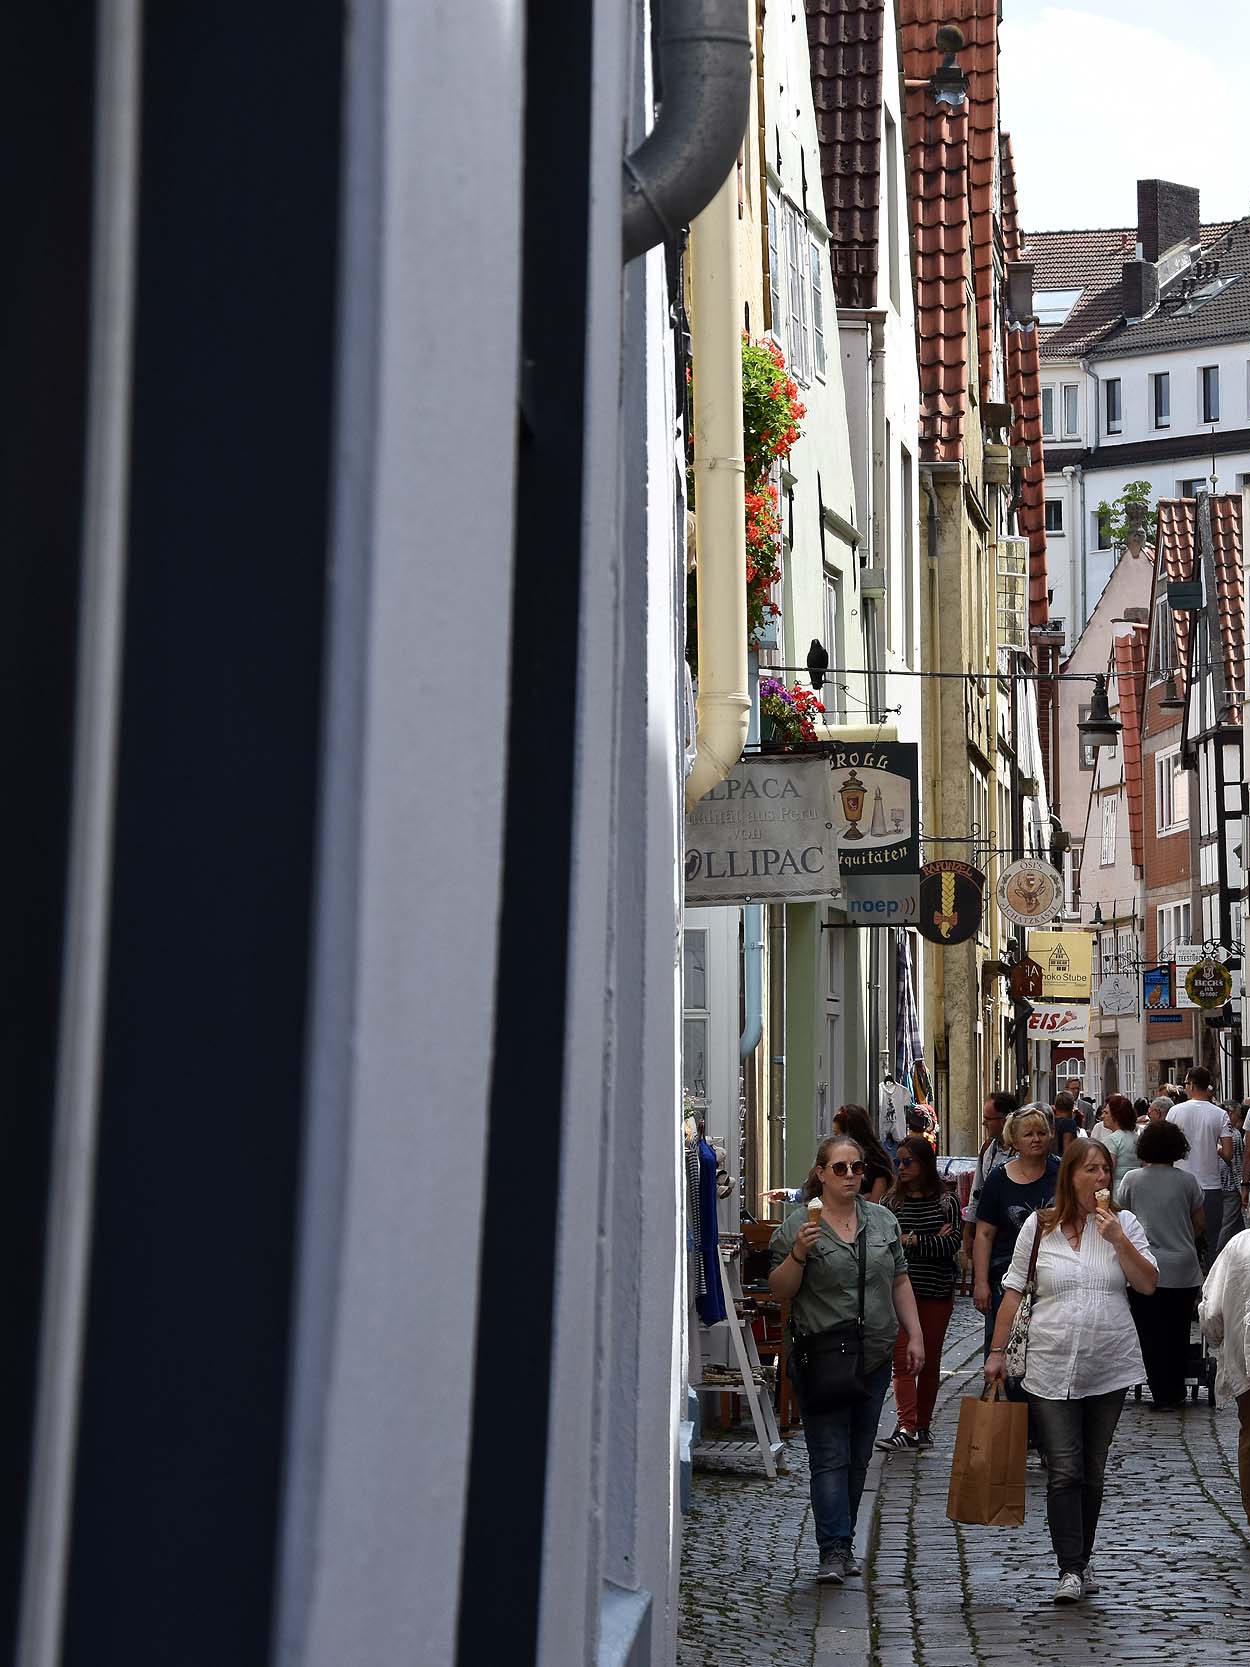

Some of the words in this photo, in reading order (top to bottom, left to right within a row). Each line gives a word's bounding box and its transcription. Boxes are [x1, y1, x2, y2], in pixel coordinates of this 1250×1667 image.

[700, 778, 802, 801] LPACA
[839, 846, 908, 868] iquitäten
[922, 861, 973, 877] RAPUNZEL
[851, 900, 899, 918] noep
[1063, 973, 1087, 982] Stube
[1029, 1013, 1061, 1030] EIS
